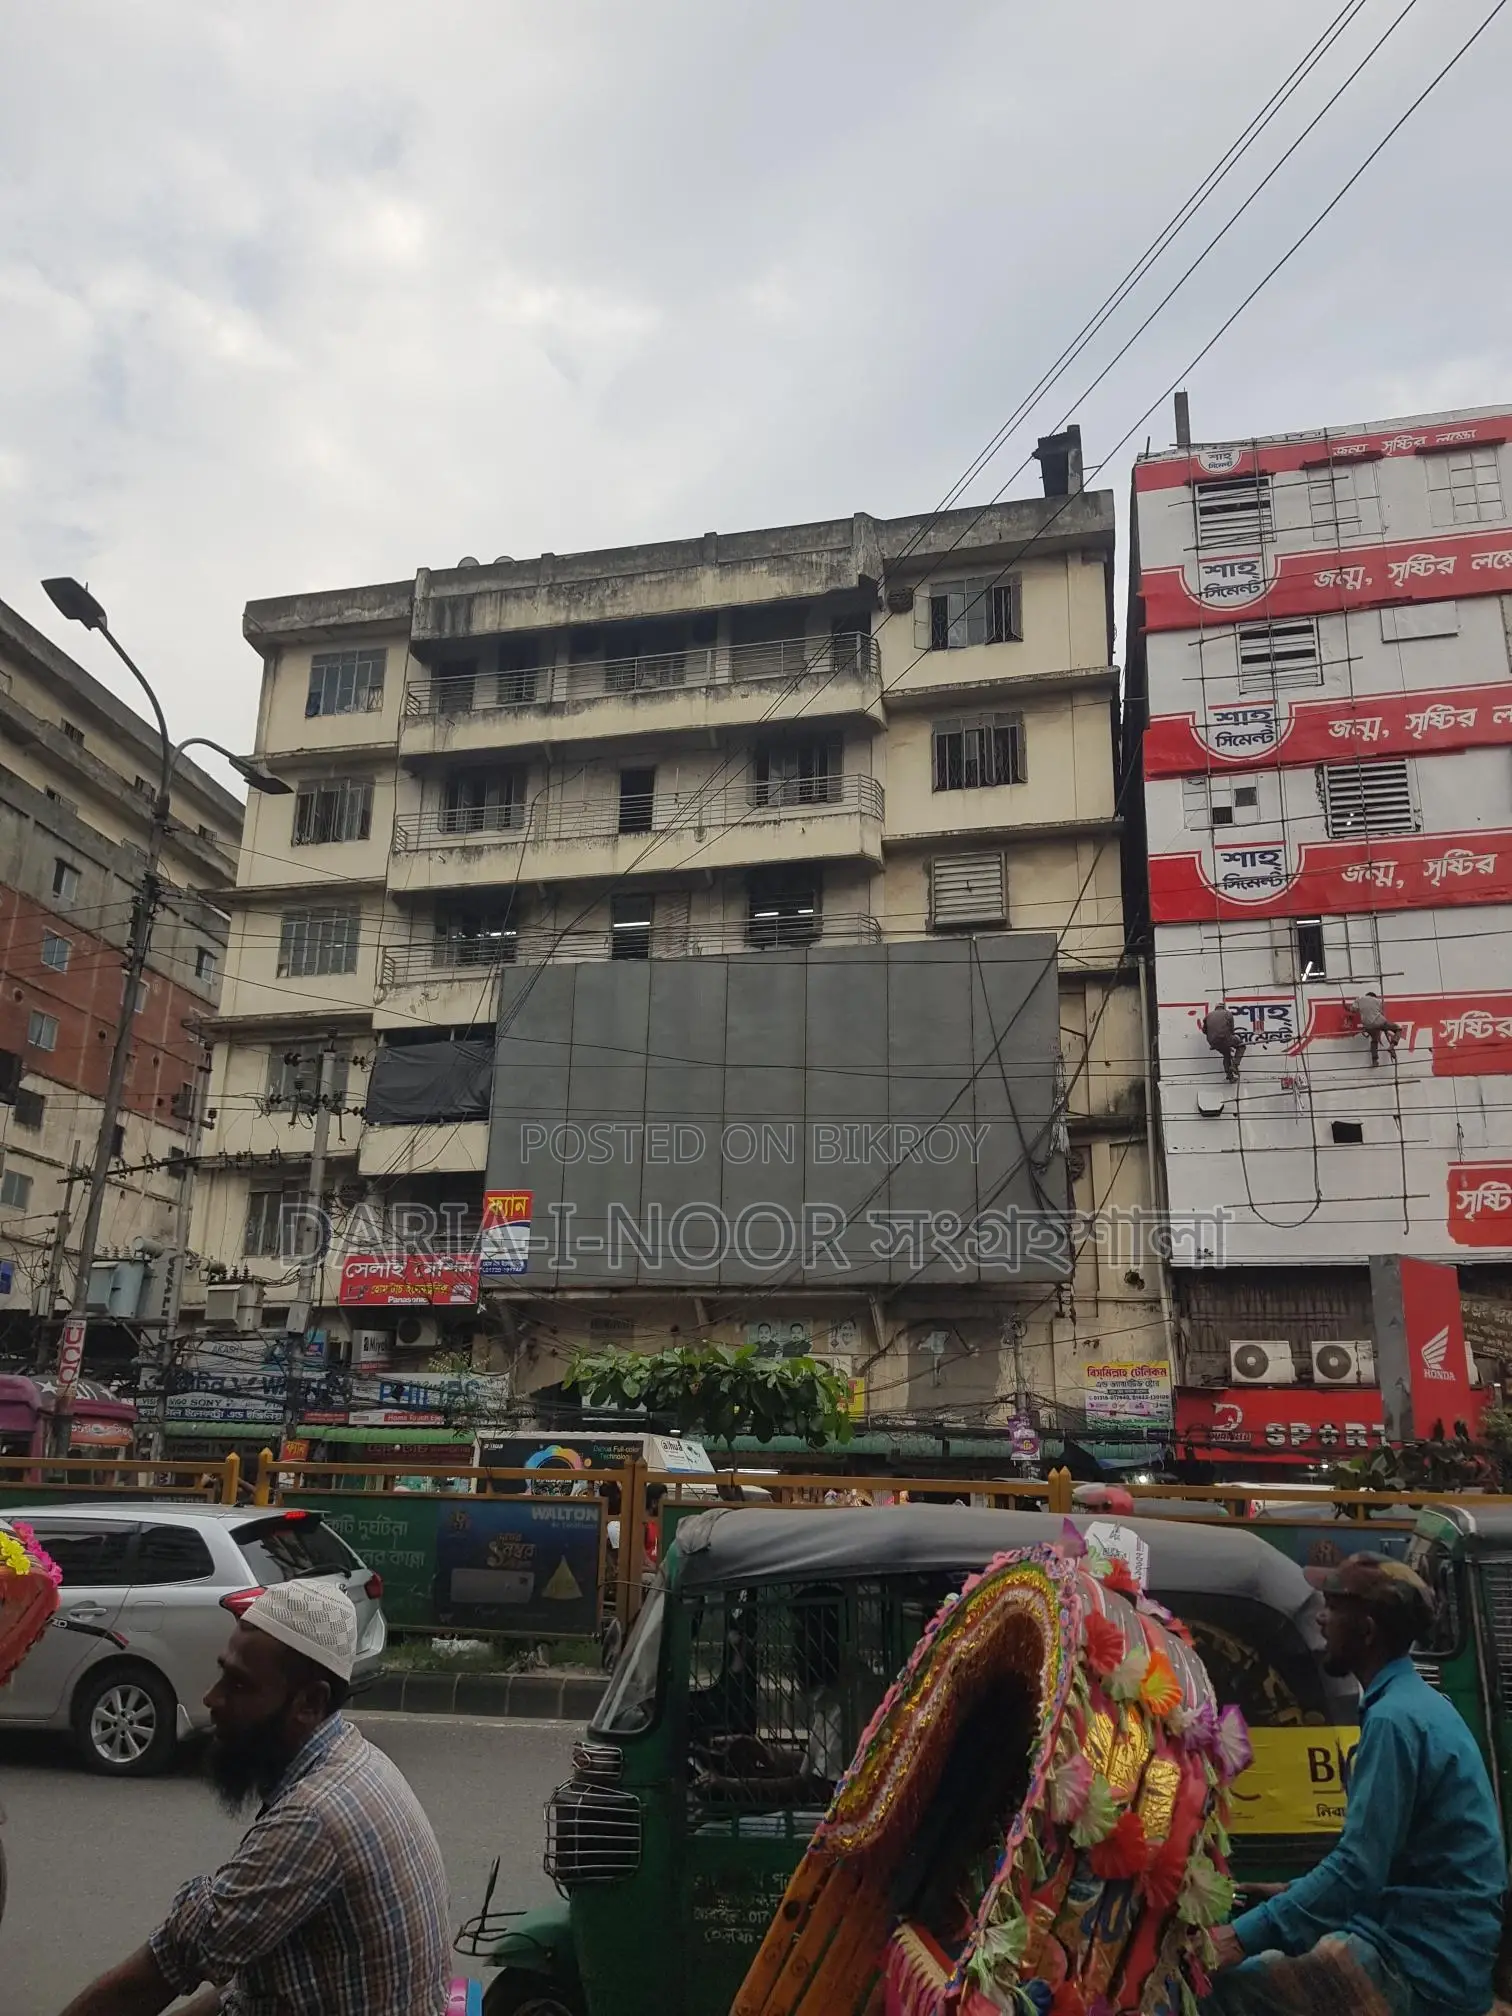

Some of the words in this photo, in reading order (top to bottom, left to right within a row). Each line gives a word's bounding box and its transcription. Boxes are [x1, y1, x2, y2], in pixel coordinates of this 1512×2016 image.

[1387, 554, 1457, 587] সৃষ্টির
[1203, 581, 1261, 599] সিমেন্ট
[1405, 703, 1477, 740] সৃষ্টির
[1215, 729, 1275, 748] সিমেন্ট
[1423, 849, 1499, 887] সৃষ্টির
[487, 1193, 529, 1217] ফ্যান
[345, 1257, 405, 1279] সেলাই
[387, 1296, 429, 1304] Panasonic
[59, 1327, 85, 1385] UCC
[1423, 1368, 1456, 1381] HONDA
[190, 1399, 222, 1407] SONY
[531, 1506, 599, 1521] WALTON
[357, 1513, 409, 1541] দুর্ঘটনা
